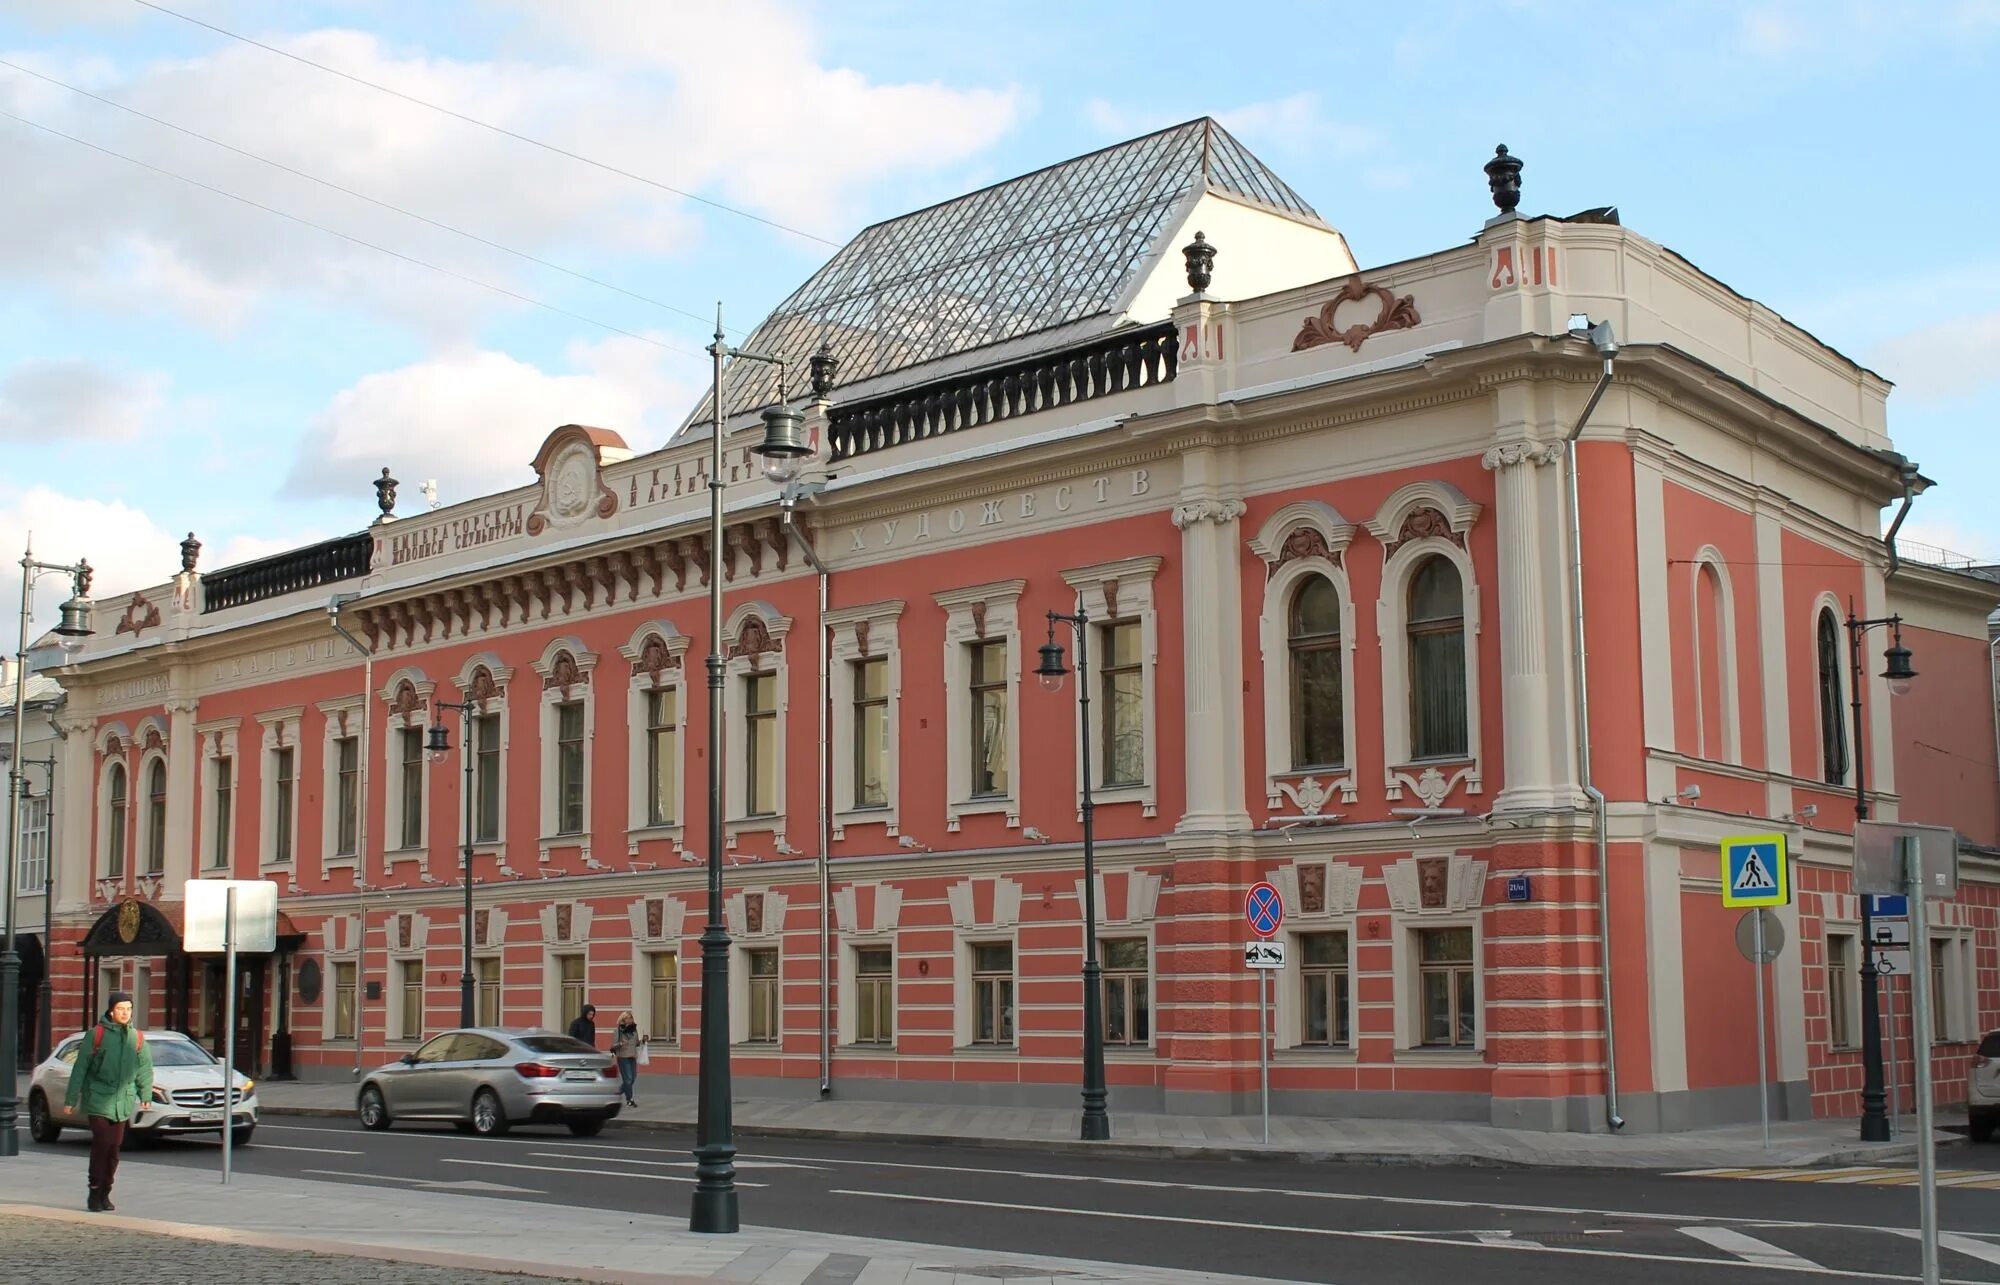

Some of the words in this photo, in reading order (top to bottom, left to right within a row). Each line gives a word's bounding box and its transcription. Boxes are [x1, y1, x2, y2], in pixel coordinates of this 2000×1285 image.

[393, 504, 522, 551] ИМПЕРАТОРСКАЯ
[455, 519, 522, 549] СКУЛЬПТУРЫ
[648, 462, 764, 503] АРХИТКТ.
[851, 469, 1149, 552] ХУДОЖЕСТВ
